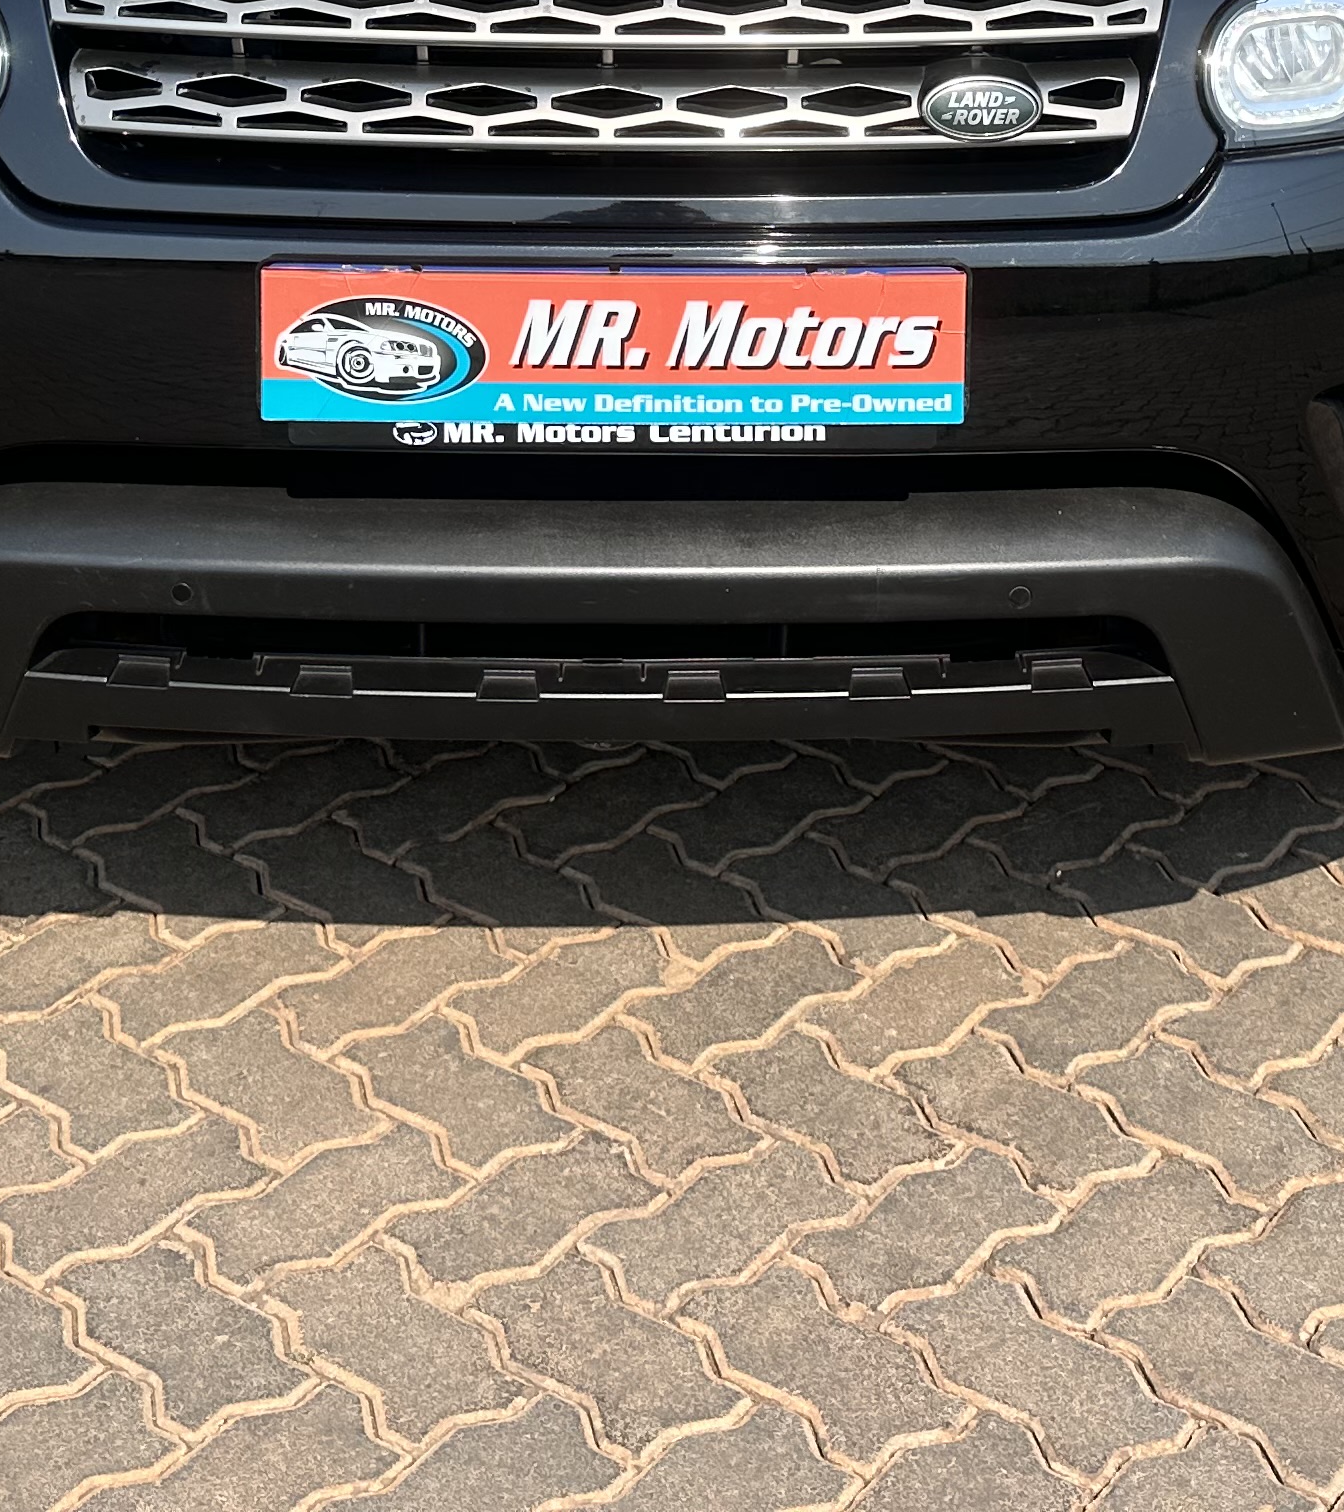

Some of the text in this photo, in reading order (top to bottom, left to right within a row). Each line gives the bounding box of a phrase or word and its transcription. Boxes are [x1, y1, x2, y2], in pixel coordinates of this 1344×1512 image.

[948, 91, 1003, 108] LAND
[952, 109, 1020, 126] ROVER
[365, 302, 477, 348] MR. MOTORS
[508, 299, 941, 370] MR. Motors
[493, 392, 953, 414] A New Definition to Pre-Owned
[444, 423, 826, 444] MR. Motors Centurion
